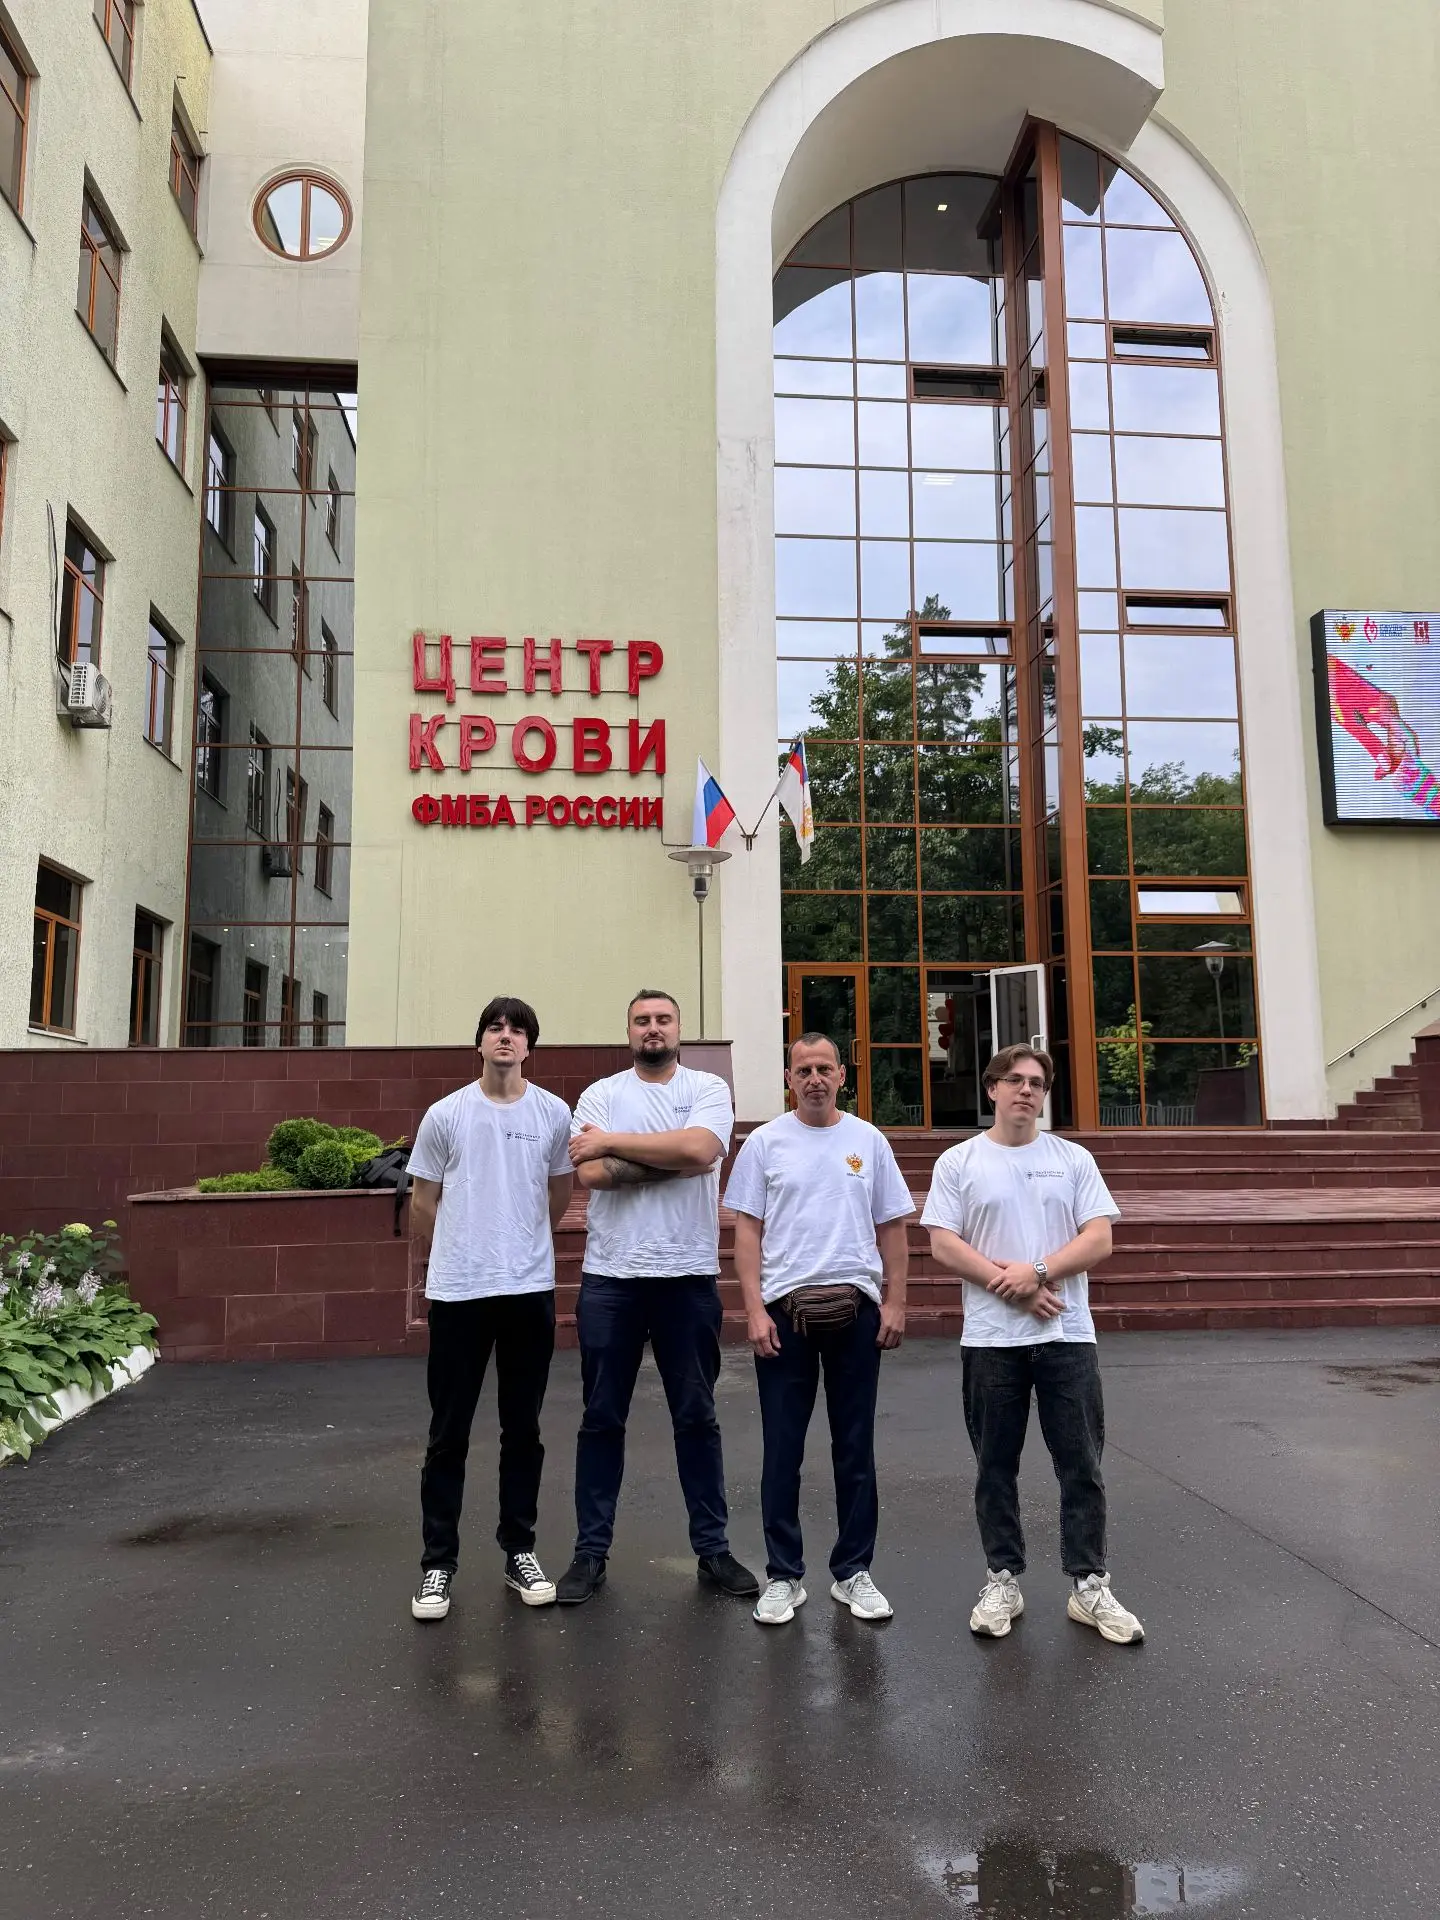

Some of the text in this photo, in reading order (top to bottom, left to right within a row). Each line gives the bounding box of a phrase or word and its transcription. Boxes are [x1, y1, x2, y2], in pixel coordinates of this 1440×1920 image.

[413, 633, 664, 703] ЦЕНТР
[409, 713, 666, 774] КРОВИ
[412, 794, 664, 829] ФМБА РОССИИ
